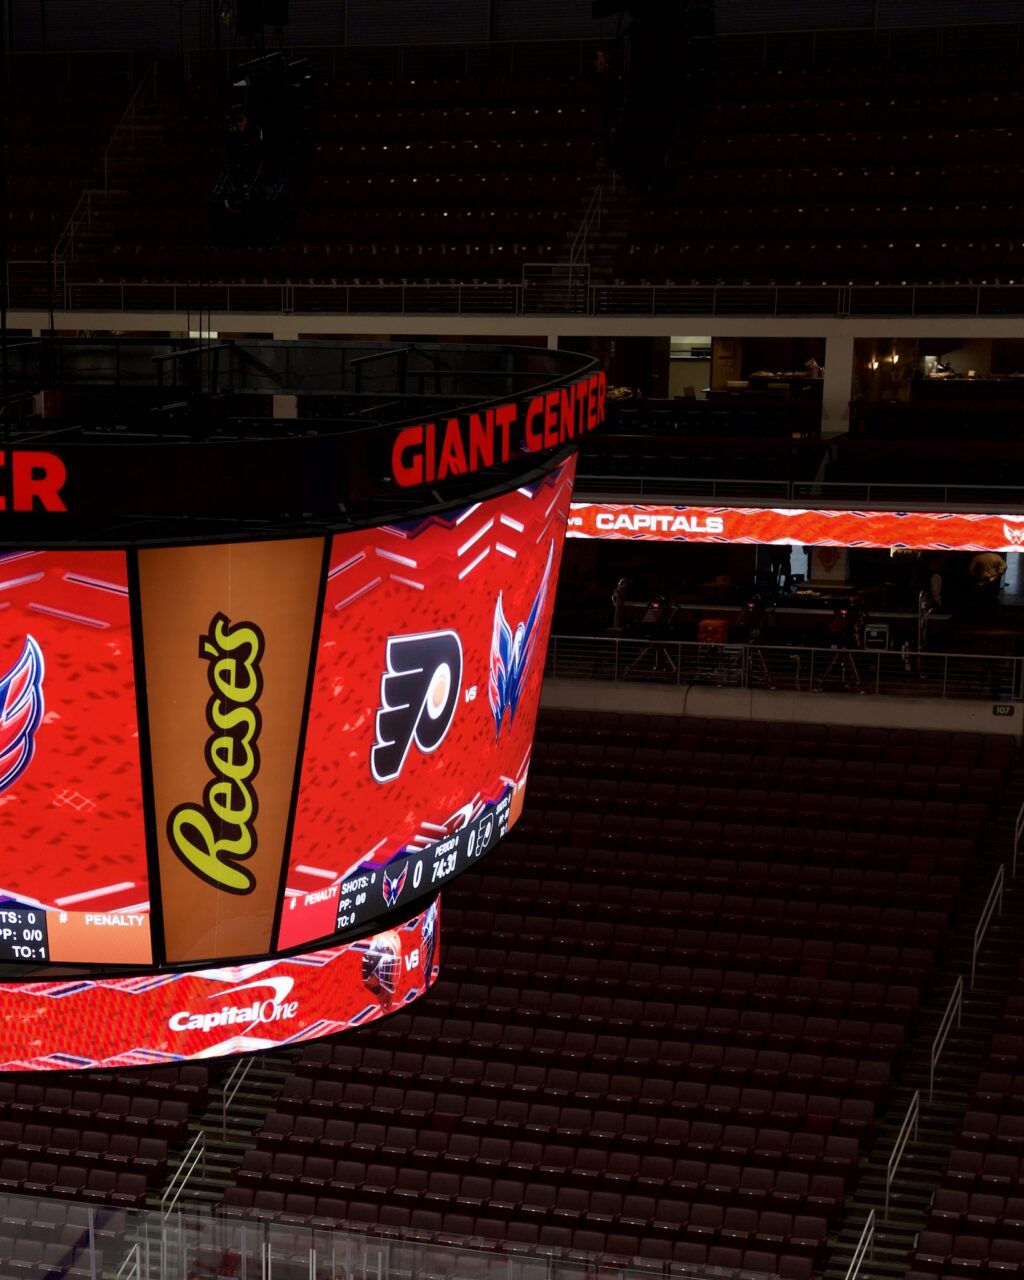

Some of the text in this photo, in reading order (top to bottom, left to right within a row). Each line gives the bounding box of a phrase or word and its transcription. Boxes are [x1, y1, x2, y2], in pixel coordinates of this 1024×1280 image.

[392, 371, 606, 487] GIANT CENTER
[595, 513, 724, 533] CAPITALS
[996, 705, 1010, 714] 107
[170, 615, 262, 892] Reese's
[467, 829, 476, 858] 0
[413, 860, 423, 889] 0
[341, 875, 369, 895] SHOTS:
[304, 886, 338, 906] PENALTY
[338, 898, 352, 912] PP:
[27, 912, 36, 925] 0
[58, 912, 145, 927] # PENALTY
[337, 915, 349, 929] TO:
[23, 928, 43, 942] 0/0
[12, 945, 46, 959] TO: 1
[405, 949, 419, 972] VS
